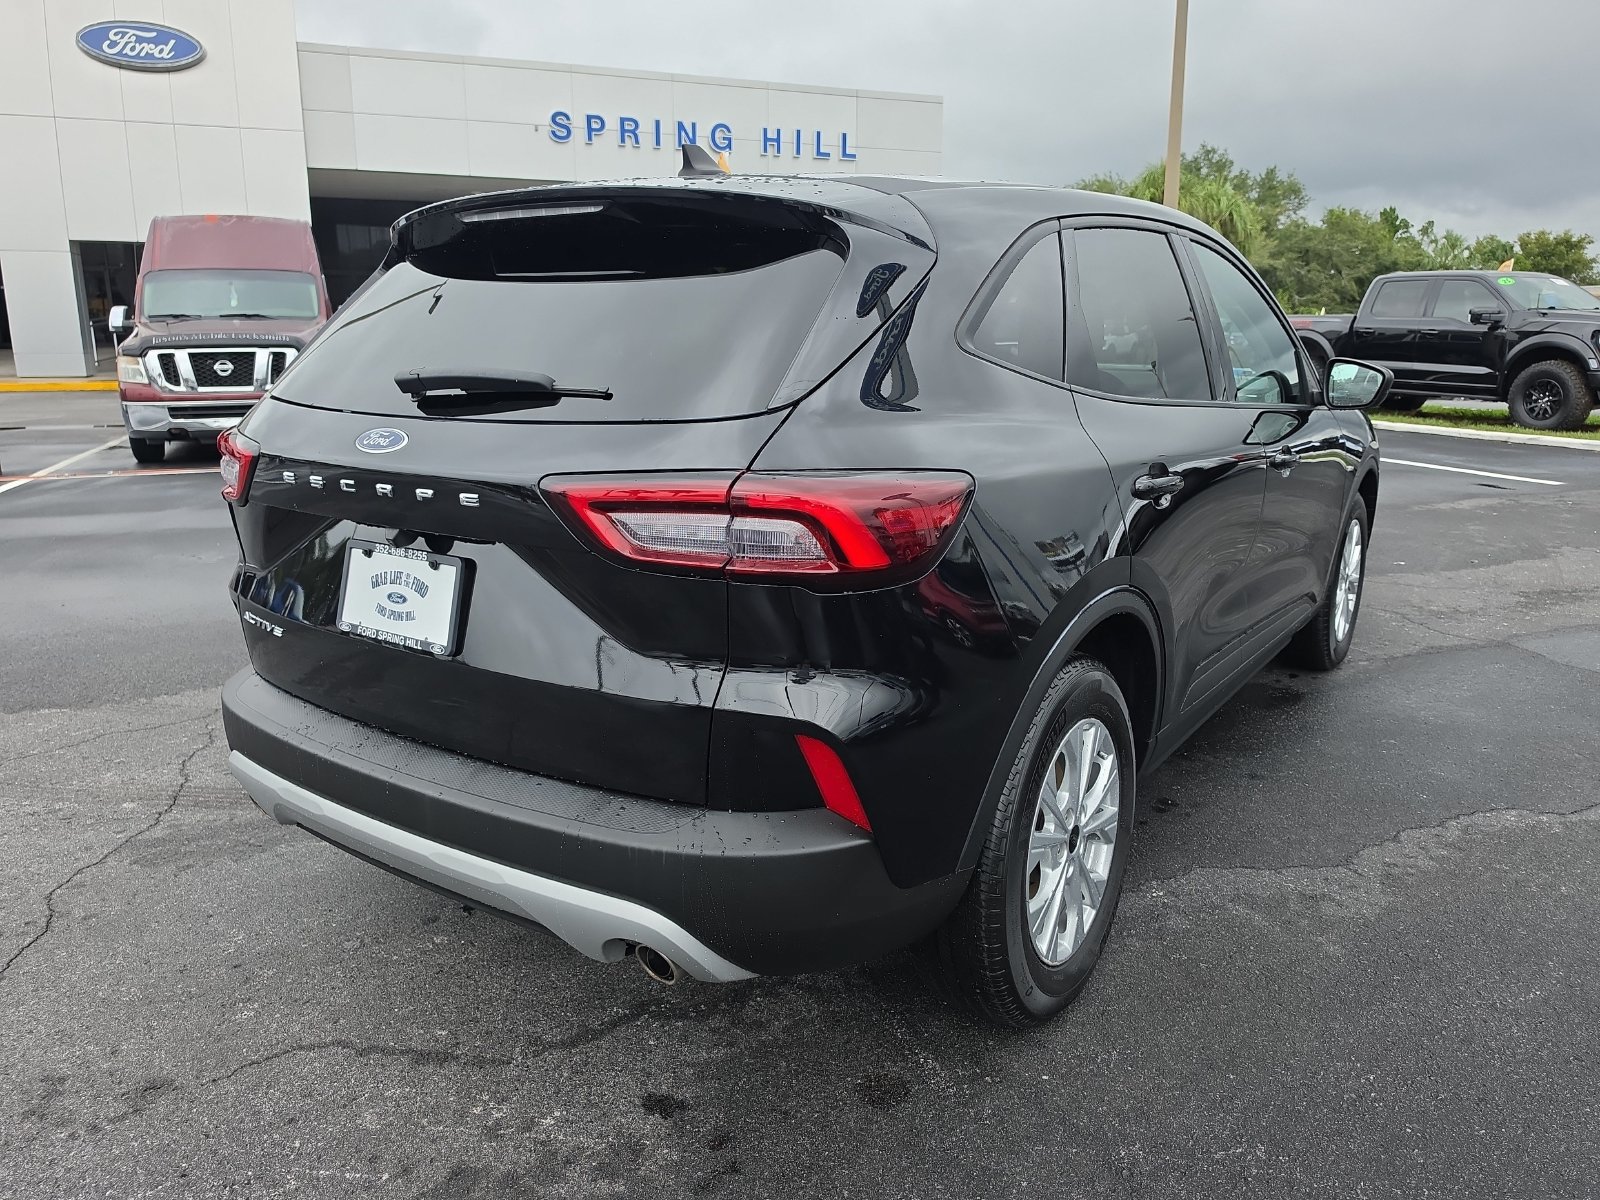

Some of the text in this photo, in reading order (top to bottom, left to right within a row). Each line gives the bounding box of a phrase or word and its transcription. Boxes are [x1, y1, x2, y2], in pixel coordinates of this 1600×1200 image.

[102, 28, 176, 59] Ford
[549, 111, 857, 160] SPRING HILL
[363, 431, 395, 446] Ford
[283, 471, 480, 507] ESCAPE
[374, 543, 428, 561] 352-686-8255
[371, 571, 388, 589] GRAB
[389, 570, 404, 585] LIFE
[410, 575, 429, 599] FORD
[243, 611, 284, 637] ACTIVE
[375, 602, 417, 622] FORD SPRING HILL
[357, 626, 423, 650] FORD SPRING HILL
